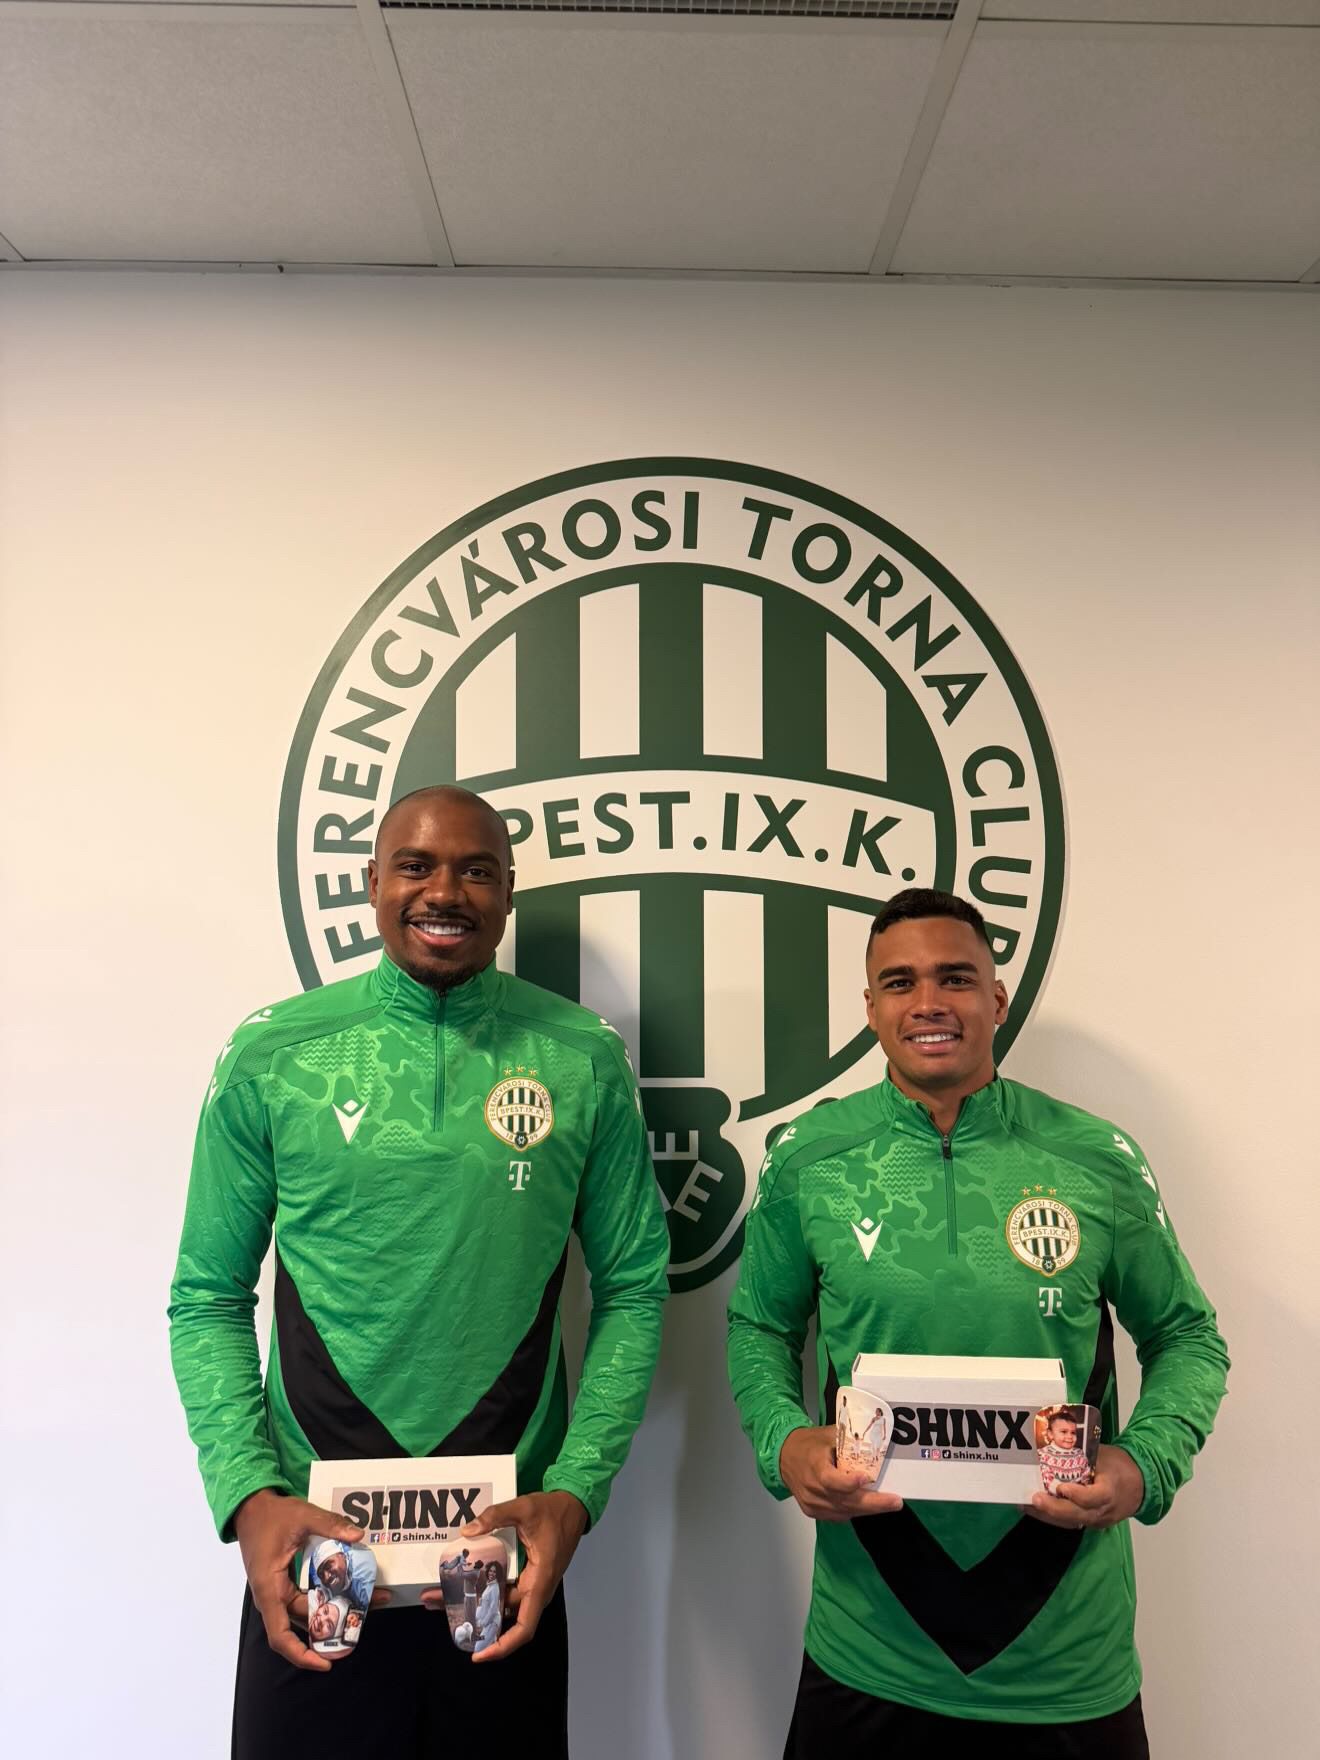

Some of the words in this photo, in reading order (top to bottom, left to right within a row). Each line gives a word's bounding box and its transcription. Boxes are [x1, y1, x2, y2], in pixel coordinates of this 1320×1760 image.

[313, 490, 699, 964] FERENCVÁROSI
[741, 497, 988, 726] TORNA
[497, 791, 916, 882] PEST.IX.K.
[1048, 1201, 1073, 1222] TORNA
[892, 1406, 1033, 1450] SHINX
[953, 1451, 999, 1461] shinx.hu
[342, 1488, 481, 1530] SHINX
[402, 1532, 448, 1542] shinx.hu
